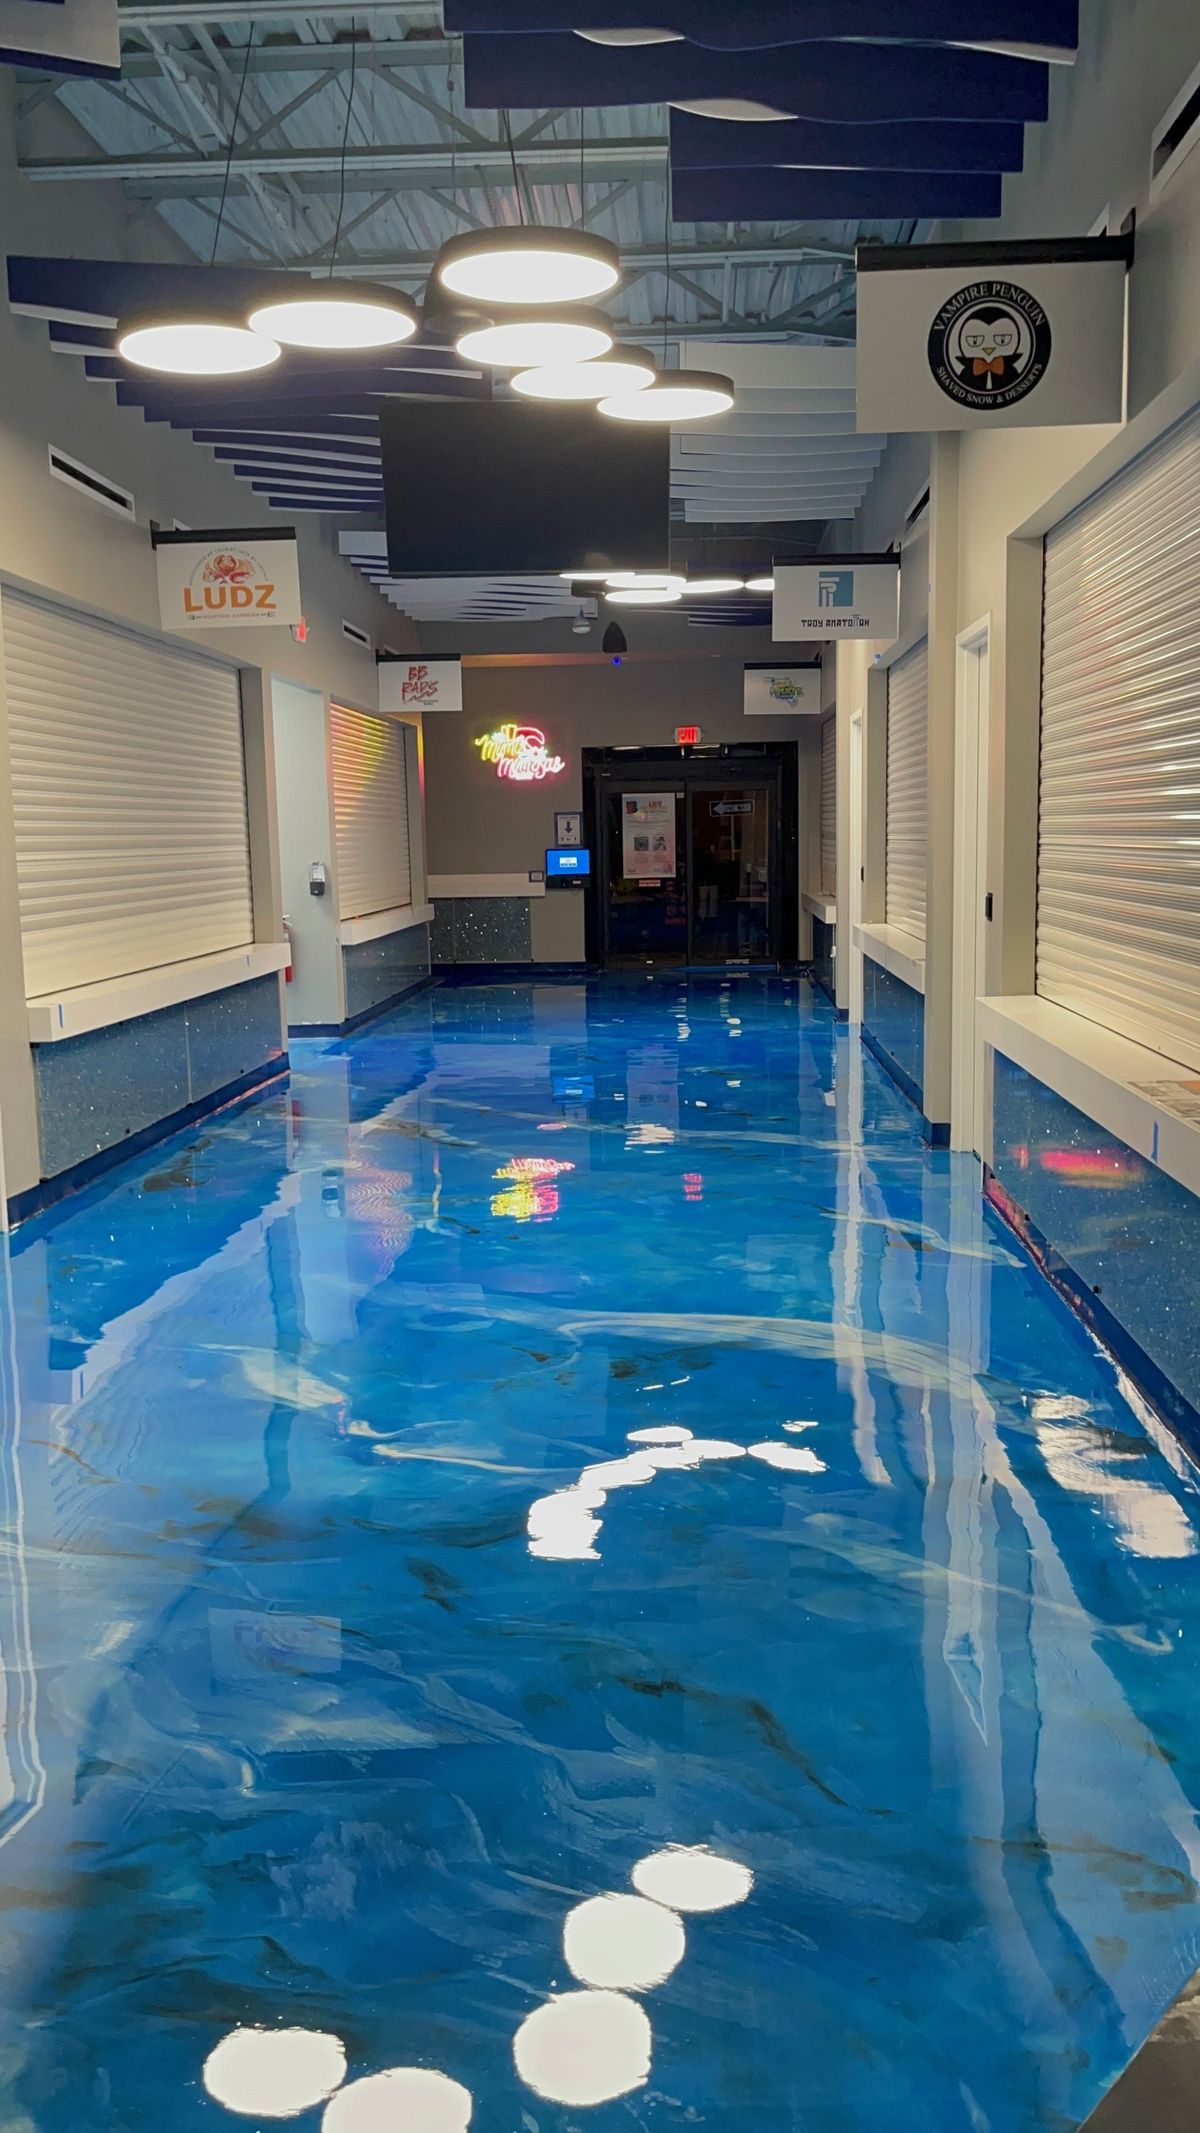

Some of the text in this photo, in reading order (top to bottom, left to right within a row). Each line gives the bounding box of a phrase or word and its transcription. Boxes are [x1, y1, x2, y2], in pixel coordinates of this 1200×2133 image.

[934, 283, 1046, 330] VAMPIRE PENGUIN
[937, 363, 1043, 405] SHAVED SNOW & DESSERTS
[183, 583, 277, 614] LUDZ
[801, 619, 823, 628] TROY
[678, 728, 697, 743] EXIT
